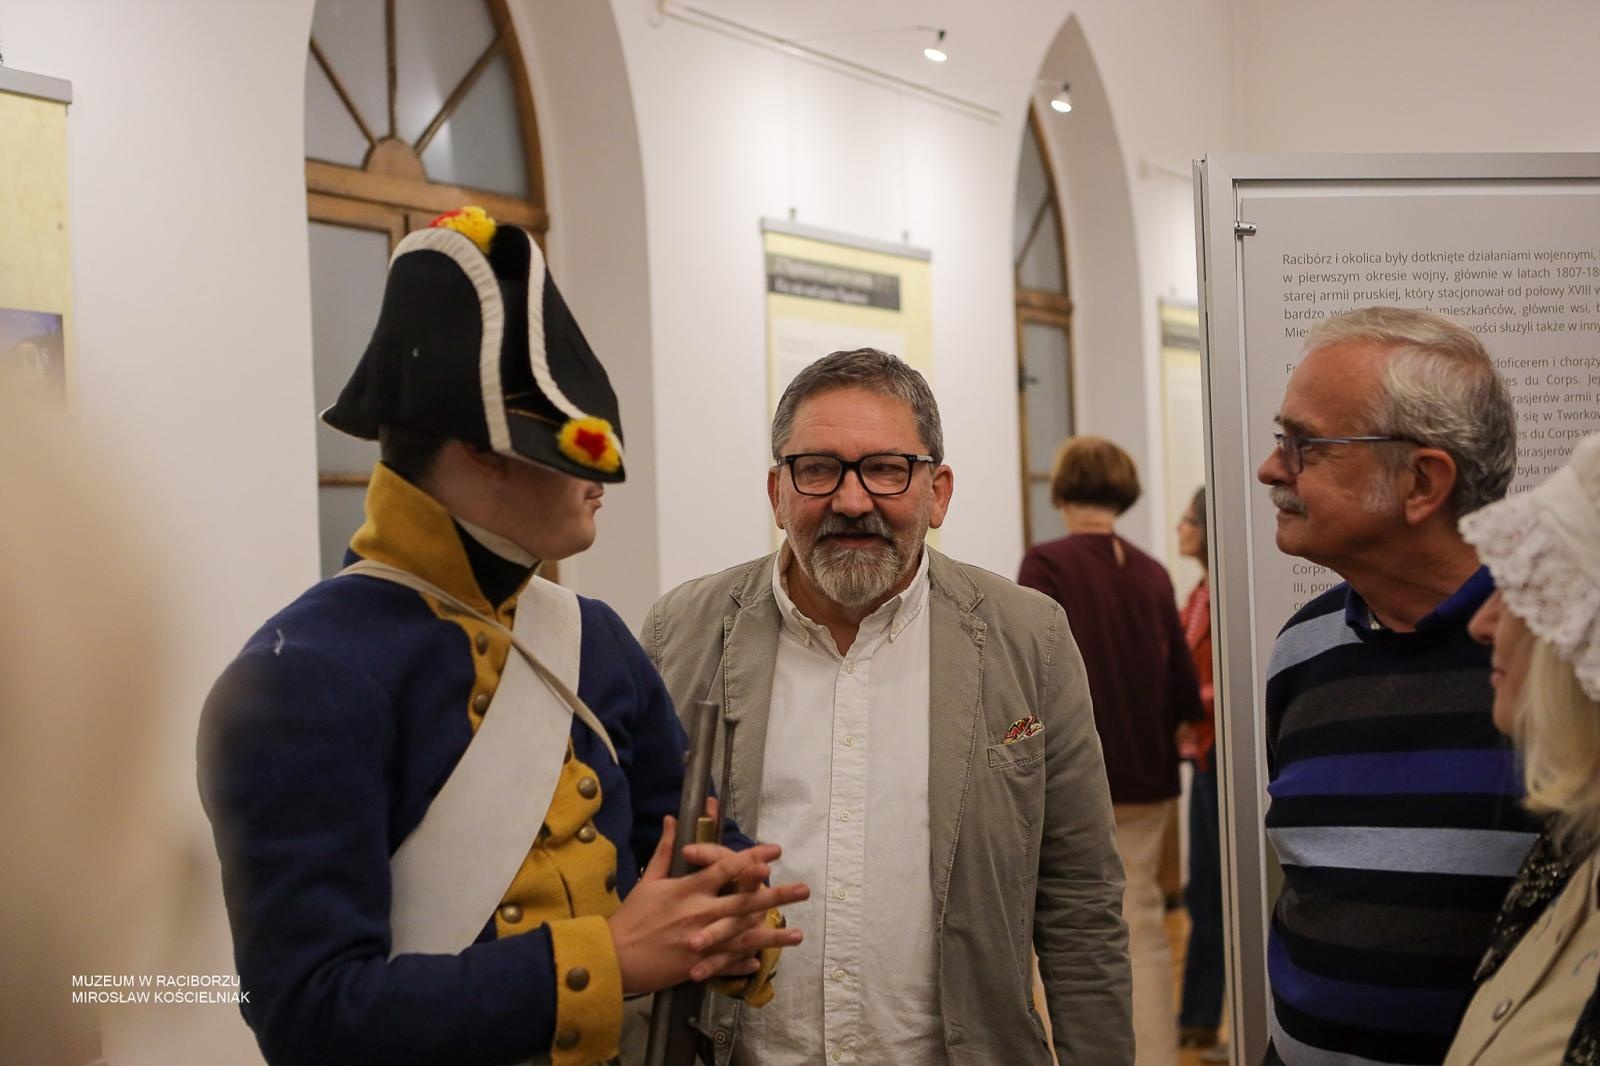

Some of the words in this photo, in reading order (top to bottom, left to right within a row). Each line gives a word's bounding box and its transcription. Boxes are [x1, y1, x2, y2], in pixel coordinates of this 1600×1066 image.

[1282, 252, 1332, 265] Racibórz
[1335, 252, 1338, 264] i
[1341, 252, 1382, 264] okolica
[1385, 251, 1408, 266] były
[1411, 250, 1465, 264] dotknięte
[1468, 249, 1531, 262] działaniami
[1534, 248, 1596, 263] wojennymi,
[1282, 273, 1293, 283] w
[1298, 271, 1360, 286] pierwszym
[1365, 270, 1407, 281] okresie
[1412, 269, 1449, 283] wojny,
[1454, 267, 1498, 283] głównie
[1503, 269, 1512, 279] w
[1517, 267, 1551, 279] latach
[1283, 290, 1316, 303] starej
[1319, 289, 1349, 301] armii
[1353, 287, 1401, 303] pruskiej,
[1405, 287, 1434, 301] który
[1437, 285, 1504, 300] stacjonował
[1507, 285, 1522, 297] od
[1525, 285, 1565, 299] połowy
[1568, 285, 1591, 296] XVIII
[1284, 308, 1325, 320] bardzo
[1439, 303, 1516, 317] mieszkańców,
[1522, 303, 1565, 317] głównie
[1570, 302, 1591, 314] wsi,
[1500, 321, 1533, 335] służyli
[1536, 320, 1565, 333] także
[1568, 322, 1577, 331] w
[1494, 356, 1549, 369] doficerem
[1525, 374, 1538, 385] du
[1512, 391, 1559, 406] rasjerów
[1563, 392, 1592, 402] armii
[1523, 410, 1539, 424] się
[1543, 412, 1553, 421] w
[1530, 428, 1545, 439] du
[1548, 428, 1580, 440] Corps
[1517, 464, 1540, 478] była
